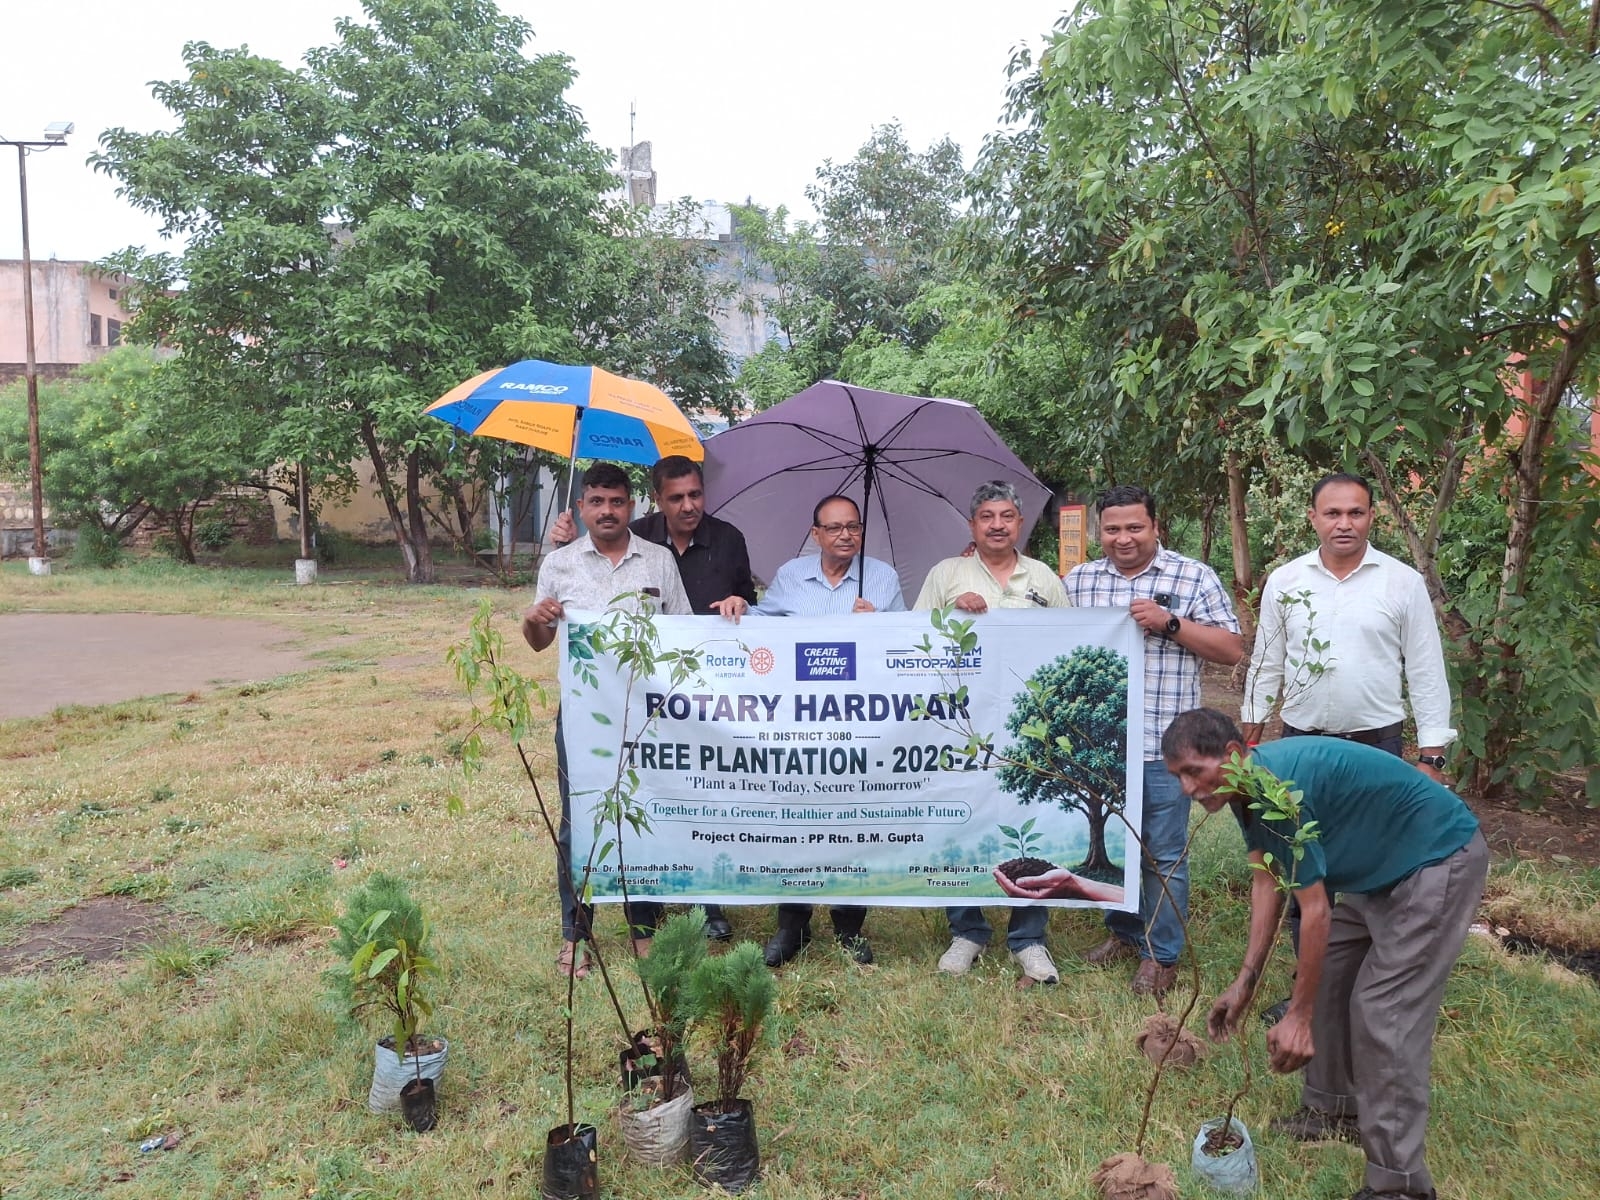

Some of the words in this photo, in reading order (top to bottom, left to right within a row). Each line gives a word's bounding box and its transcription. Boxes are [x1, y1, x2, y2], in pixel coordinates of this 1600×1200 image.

[499, 382, 569, 392] RAMCO
[804, 648, 839, 656] CREATE
[706, 655, 746, 669] Rotary
[807, 657, 847, 666] LASTING
[886, 658, 982, 669] UNSTOPPABLE
[809, 667, 845, 676] IMPACT
[646, 692, 782, 722] ROTARY
[795, 693, 970, 722] HARDWAR
[758, 732, 770, 741] RI
[773, 732, 824, 741] DISTRICT
[827, 732, 852, 740] 3080
[623, 742, 690, 770] TREE
[700, 744, 866, 775] PLANTATION
[892, 744, 994, 774] 2026-27
[729, 782, 736, 790] a
[739, 778, 766, 792] Tree
[769, 780, 810, 796] Today,
[814, 782, 856, 792] Secure
[652, 802, 698, 817] Together
[702, 806, 718, 816] for
[730, 807, 778, 820] Greener,
[781, 807, 834, 820] Healthier
[836, 807, 857, 820] and
[860, 806, 924, 820] Sustainable
[928, 806, 966, 818] Future
[692, 830, 735, 844] Project
[739, 832, 798, 844] Chairman
[808, 834, 824, 844] PP
[828, 834, 852, 844] Rtn.
[857, 833, 883, 843] B.M.
[887, 832, 924, 846] Gupta
[618, 864, 669, 872] Nilamadhab
[672, 864, 694, 872] Sahu
[760, 866, 813, 874] Dharmender
[824, 866, 867, 874] Mandhata
[944, 866, 970, 874] Rajiva
[782, 878, 825, 888] Secretary
[926, 878, 970, 886] Treasurer
